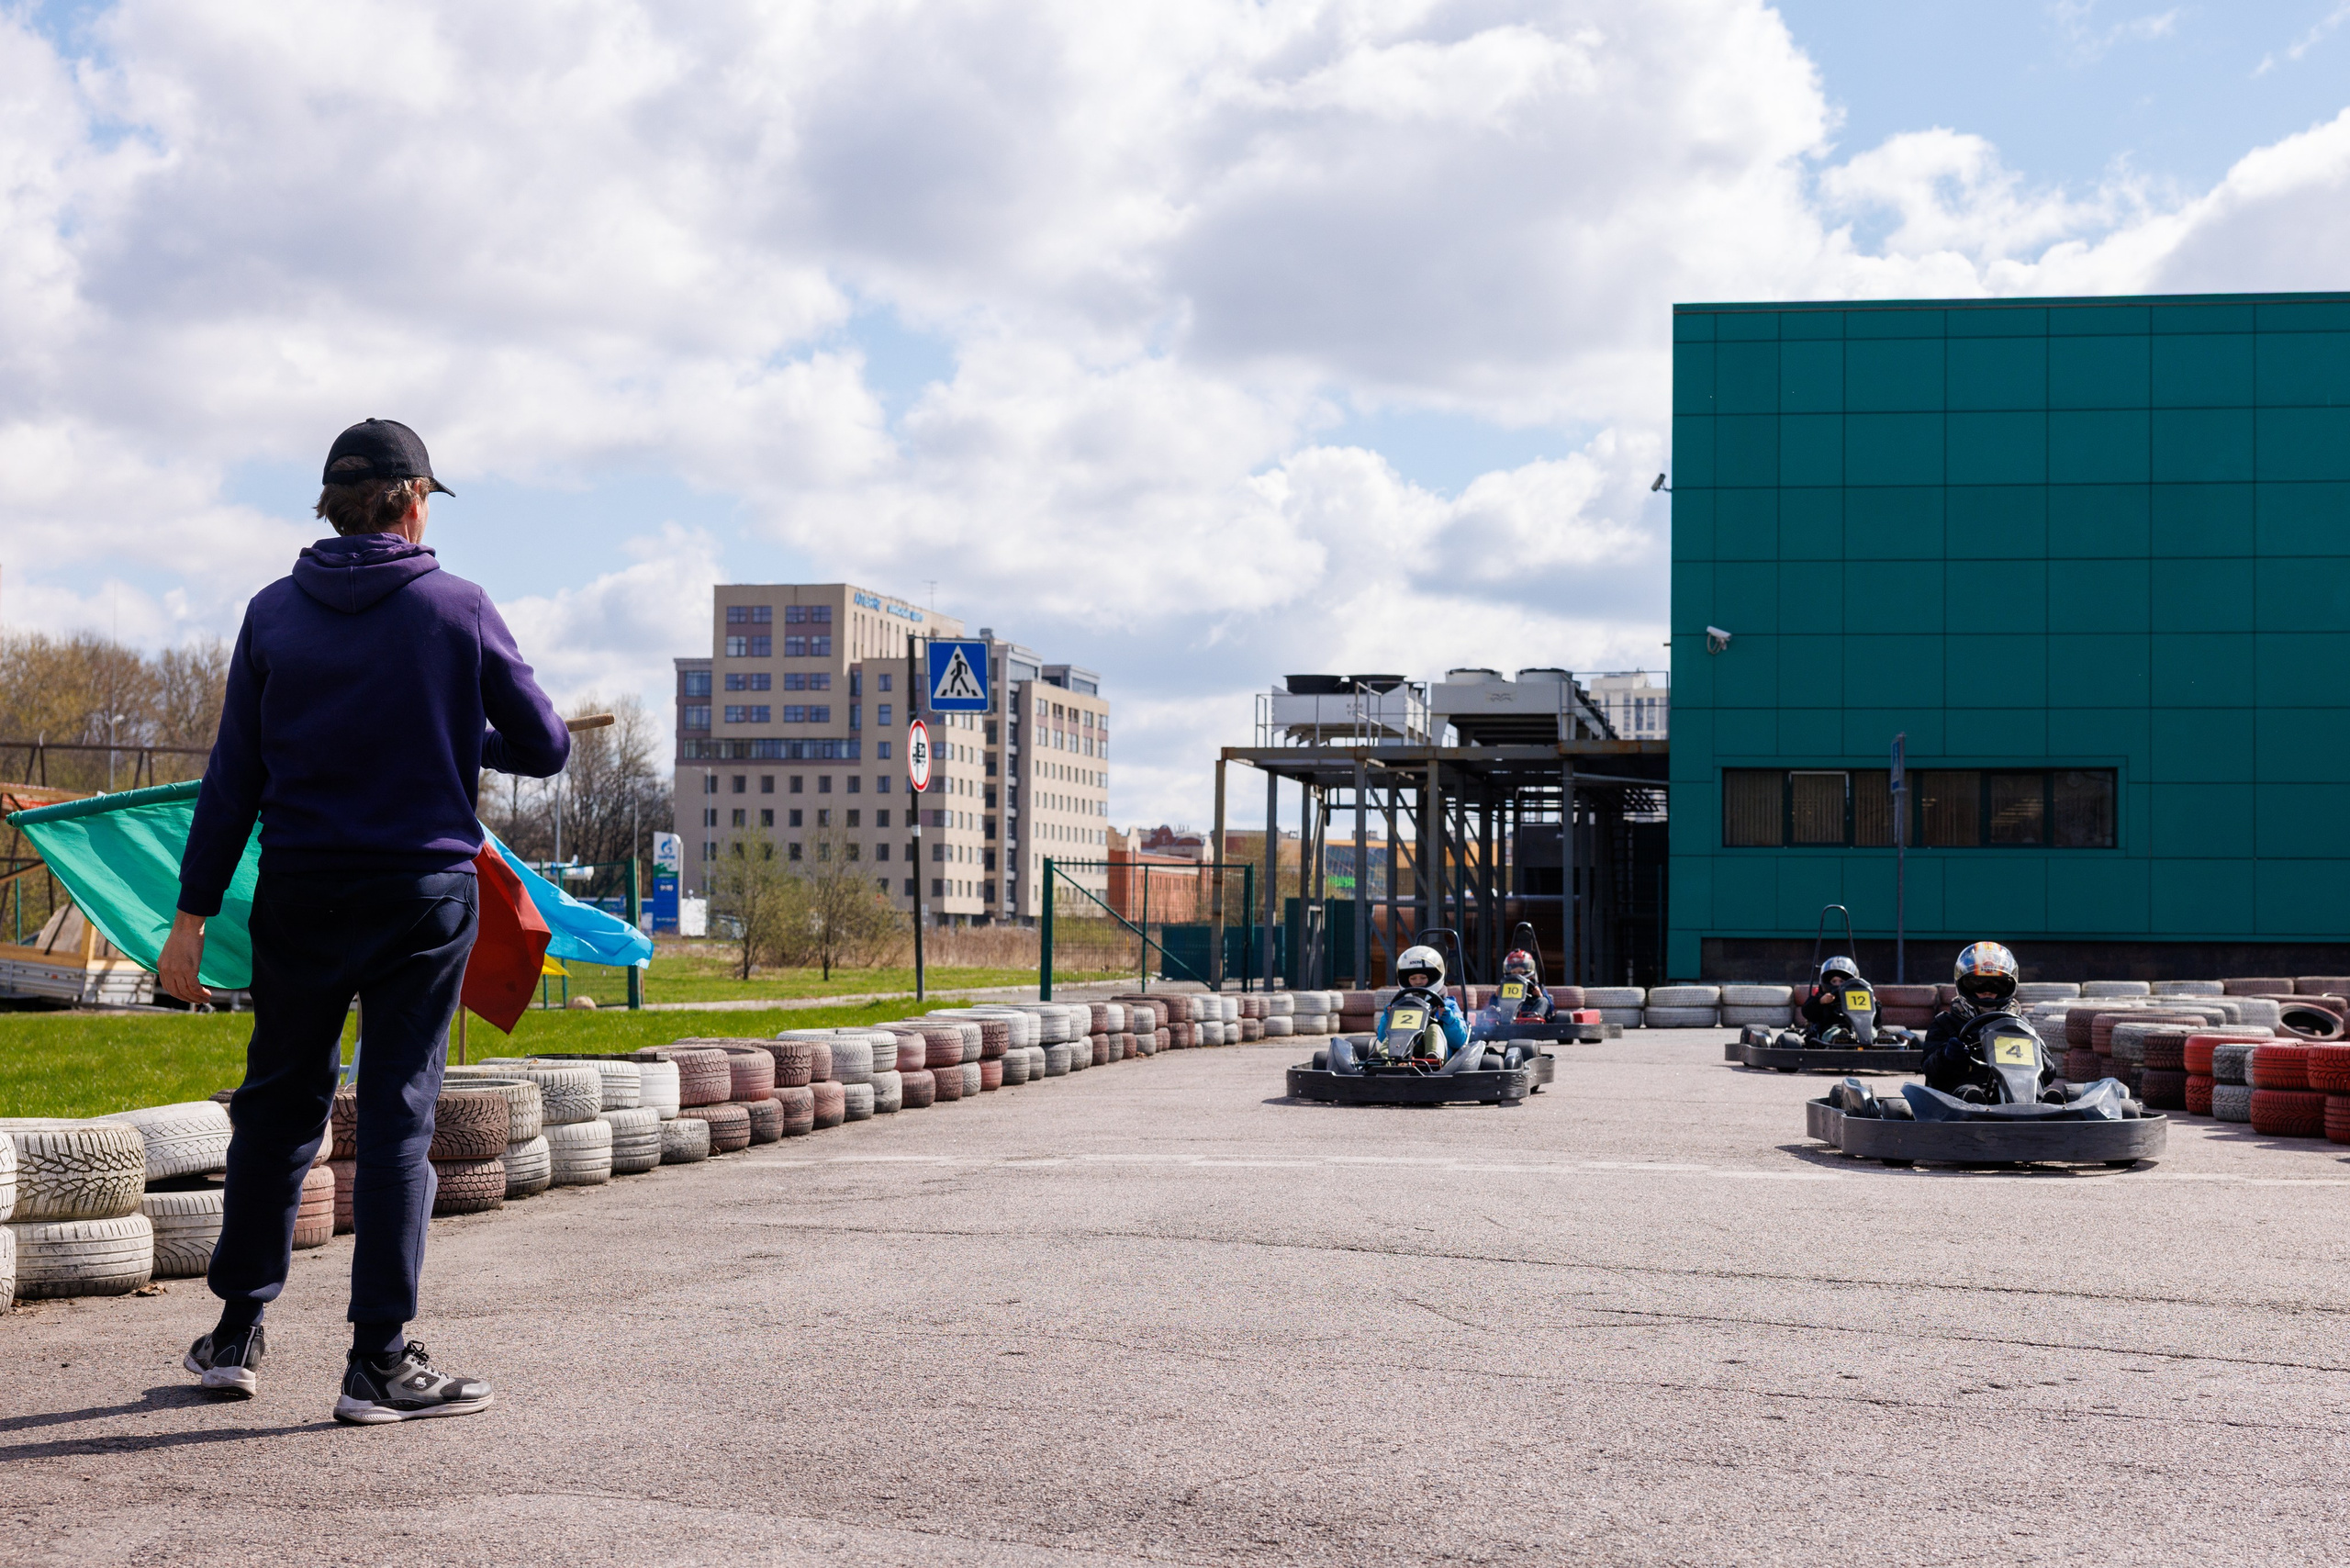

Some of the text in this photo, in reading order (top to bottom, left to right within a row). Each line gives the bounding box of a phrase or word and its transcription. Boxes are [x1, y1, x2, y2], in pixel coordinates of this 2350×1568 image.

[1507, 987, 1519, 995] 10
[1851, 995, 1866, 1006] 12
[1400, 1014, 1414, 1025] 2
[2006, 1045, 2023, 1058] 4
